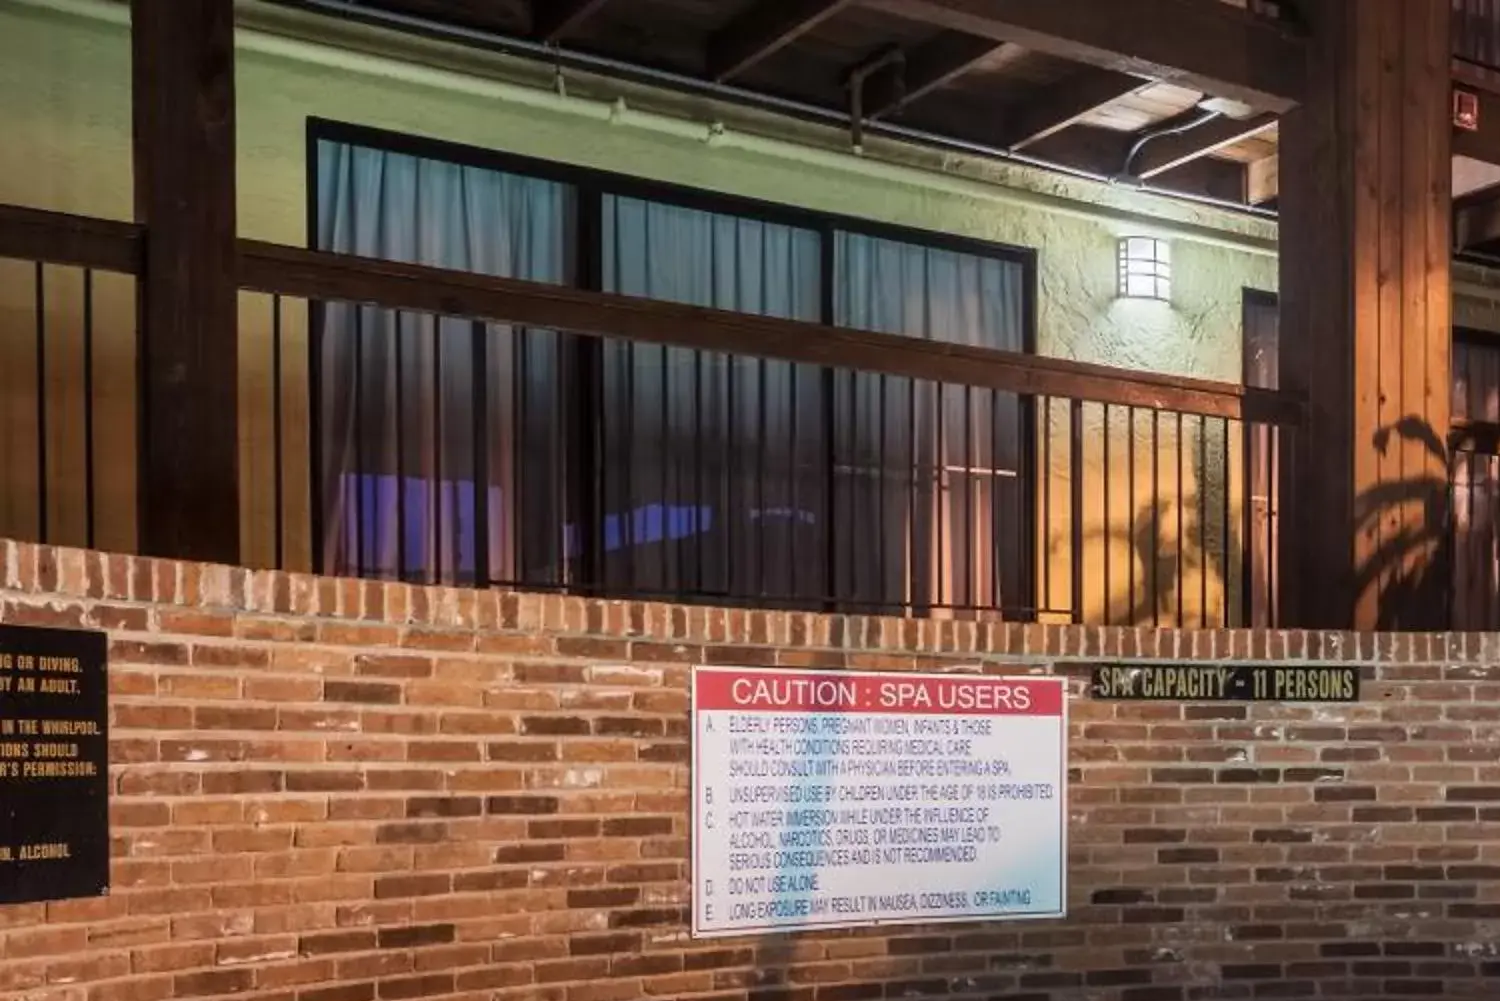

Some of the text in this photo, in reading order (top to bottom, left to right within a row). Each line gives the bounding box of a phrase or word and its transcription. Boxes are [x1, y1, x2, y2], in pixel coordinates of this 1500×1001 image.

[1100, 665, 1136, 698] SPA
[1142, 666, 1227, 698] CAPACITY
[1252, 669, 1267, 699] 11
[1275, 669, 1353, 700] PERSONS
[732, 678, 858, 706] CAUTION
[879, 682, 932, 708] SPA
[938, 684, 1031, 710] USERS
[17, 720, 39, 734] THE
[729, 715, 771, 733] ELDERLY
[822, 717, 871, 735] PREGNANT
[913, 718, 950, 735] INFANTS
[961, 719, 992, 735] THOSE
[34, 743, 79, 757] SHOULD
[729, 738, 972, 756] WITH HEALTH CONDITIONS REQUIRING MEDICAL CARE
[729, 759, 769, 777] SHOULD
[770, 759, 813, 777] CONSULT
[815, 758, 838, 775] WITH
[848, 759, 896, 776] PHYSICIAN
[898, 759, 935, 776] BEFORE
[936, 759, 983, 776] ENTERING
[730, 785, 801, 803] UNSUPERVISED
[803, 785, 824, 802] USE
[825, 785, 837, 802] BY
[839, 785, 885, 801] CHILDREN
[888, 784, 918, 801] UNDER
[921, 784, 938, 801] THE
[940, 784, 959, 801] AGE
[961, 784, 974, 800] OF
[729, 810, 750, 828] HOT
[752, 810, 784, 827] WATER
[786, 809, 838, 827] IMMERSION
[839, 808, 868, 825] WHILE
[870, 808, 902, 824] UNDER
[905, 807, 922, 824] THE
[924, 807, 974, 823] INFLUENCE
[976, 807, 989, 823] OF
[873, 828, 887, 845] OR
[889, 827, 938, 844] MEDICINES
[941, 827, 961, 843] MAY
[962, 826, 986, 843] LEAD
[988, 826, 1000, 842] TO
[729, 852, 771, 871] SERIOUS
[774, 850, 849, 869] CONSEQUENCES
[852, 849, 870, 866] AND
[871, 849, 881, 865] IS
[883, 848, 903, 865] NOT
[728, 877, 742, 895] DO
[745, 876, 765, 894] NOT
[767, 875, 785, 893] USE
[729, 902, 757, 921] LONG
[758, 899, 808, 919] EXPOSURE
[811, 899, 829, 915] MAY
[831, 897, 867, 914] RESULT
[868, 896, 877, 912] IN
[974, 890, 987, 907] OR
